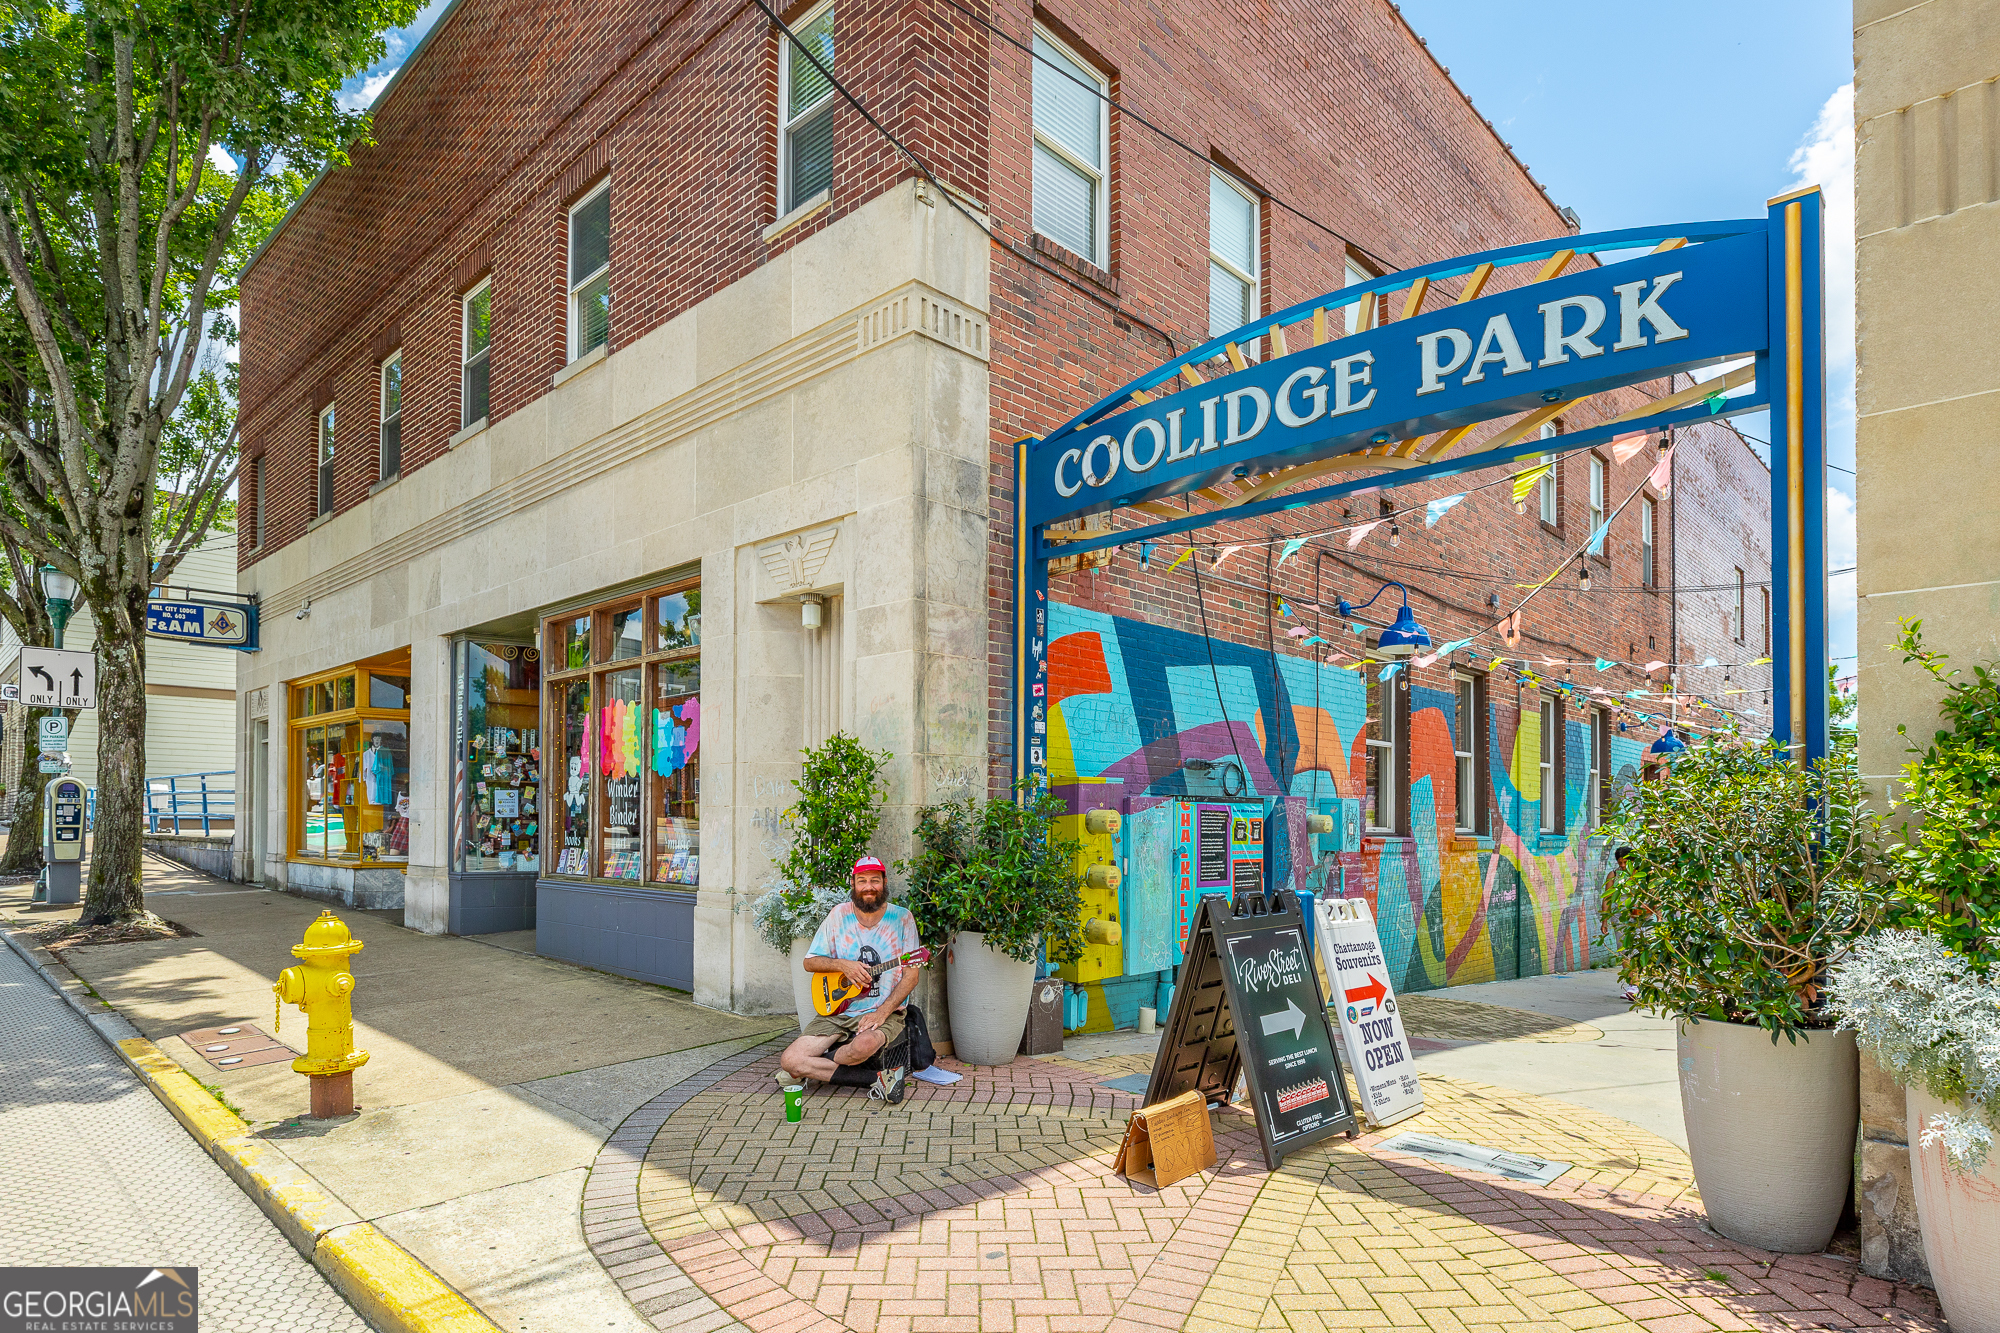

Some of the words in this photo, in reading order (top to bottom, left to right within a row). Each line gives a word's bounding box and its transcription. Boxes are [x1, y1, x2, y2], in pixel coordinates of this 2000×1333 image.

[1054, 350, 1378, 498] COOLIDGE
[1416, 271, 1690, 396] PARK
[162, 611, 172, 619] NO.
[179, 607, 197, 615] LODGE
[147, 618, 201, 634] F&AM
[218, 620, 226, 628] G
[30, 694, 54, 704] ONLY
[66, 697, 89, 706] ONLY
[49, 722, 59, 731] P
[607, 775, 639, 798] Winder
[609, 801, 637, 825] Binder
[564, 830, 581, 846] books
[616, 836, 626, 849] art
[666, 838, 691, 850] music
[1333, 940, 1377, 955] Chattanooga
[1335, 952, 1382, 971] Souvenirs
[1282, 973, 1302, 985] DELI
[1359, 1017, 1393, 1045] NOW
[1268, 1056, 1286, 1066] SERVING
[1294, 1050, 1304, 1058] BEST
[1304, 1047, 1318, 1056] LUNCH
[1365, 1041, 1404, 1072] OPEN
[1285, 1060, 1297, 1069] SINCE
[1296, 1116, 1312, 1127] GLUTEN
[1312, 1112, 1323, 1121] FREE
[1302, 1121, 1320, 1131] OPTIONS
